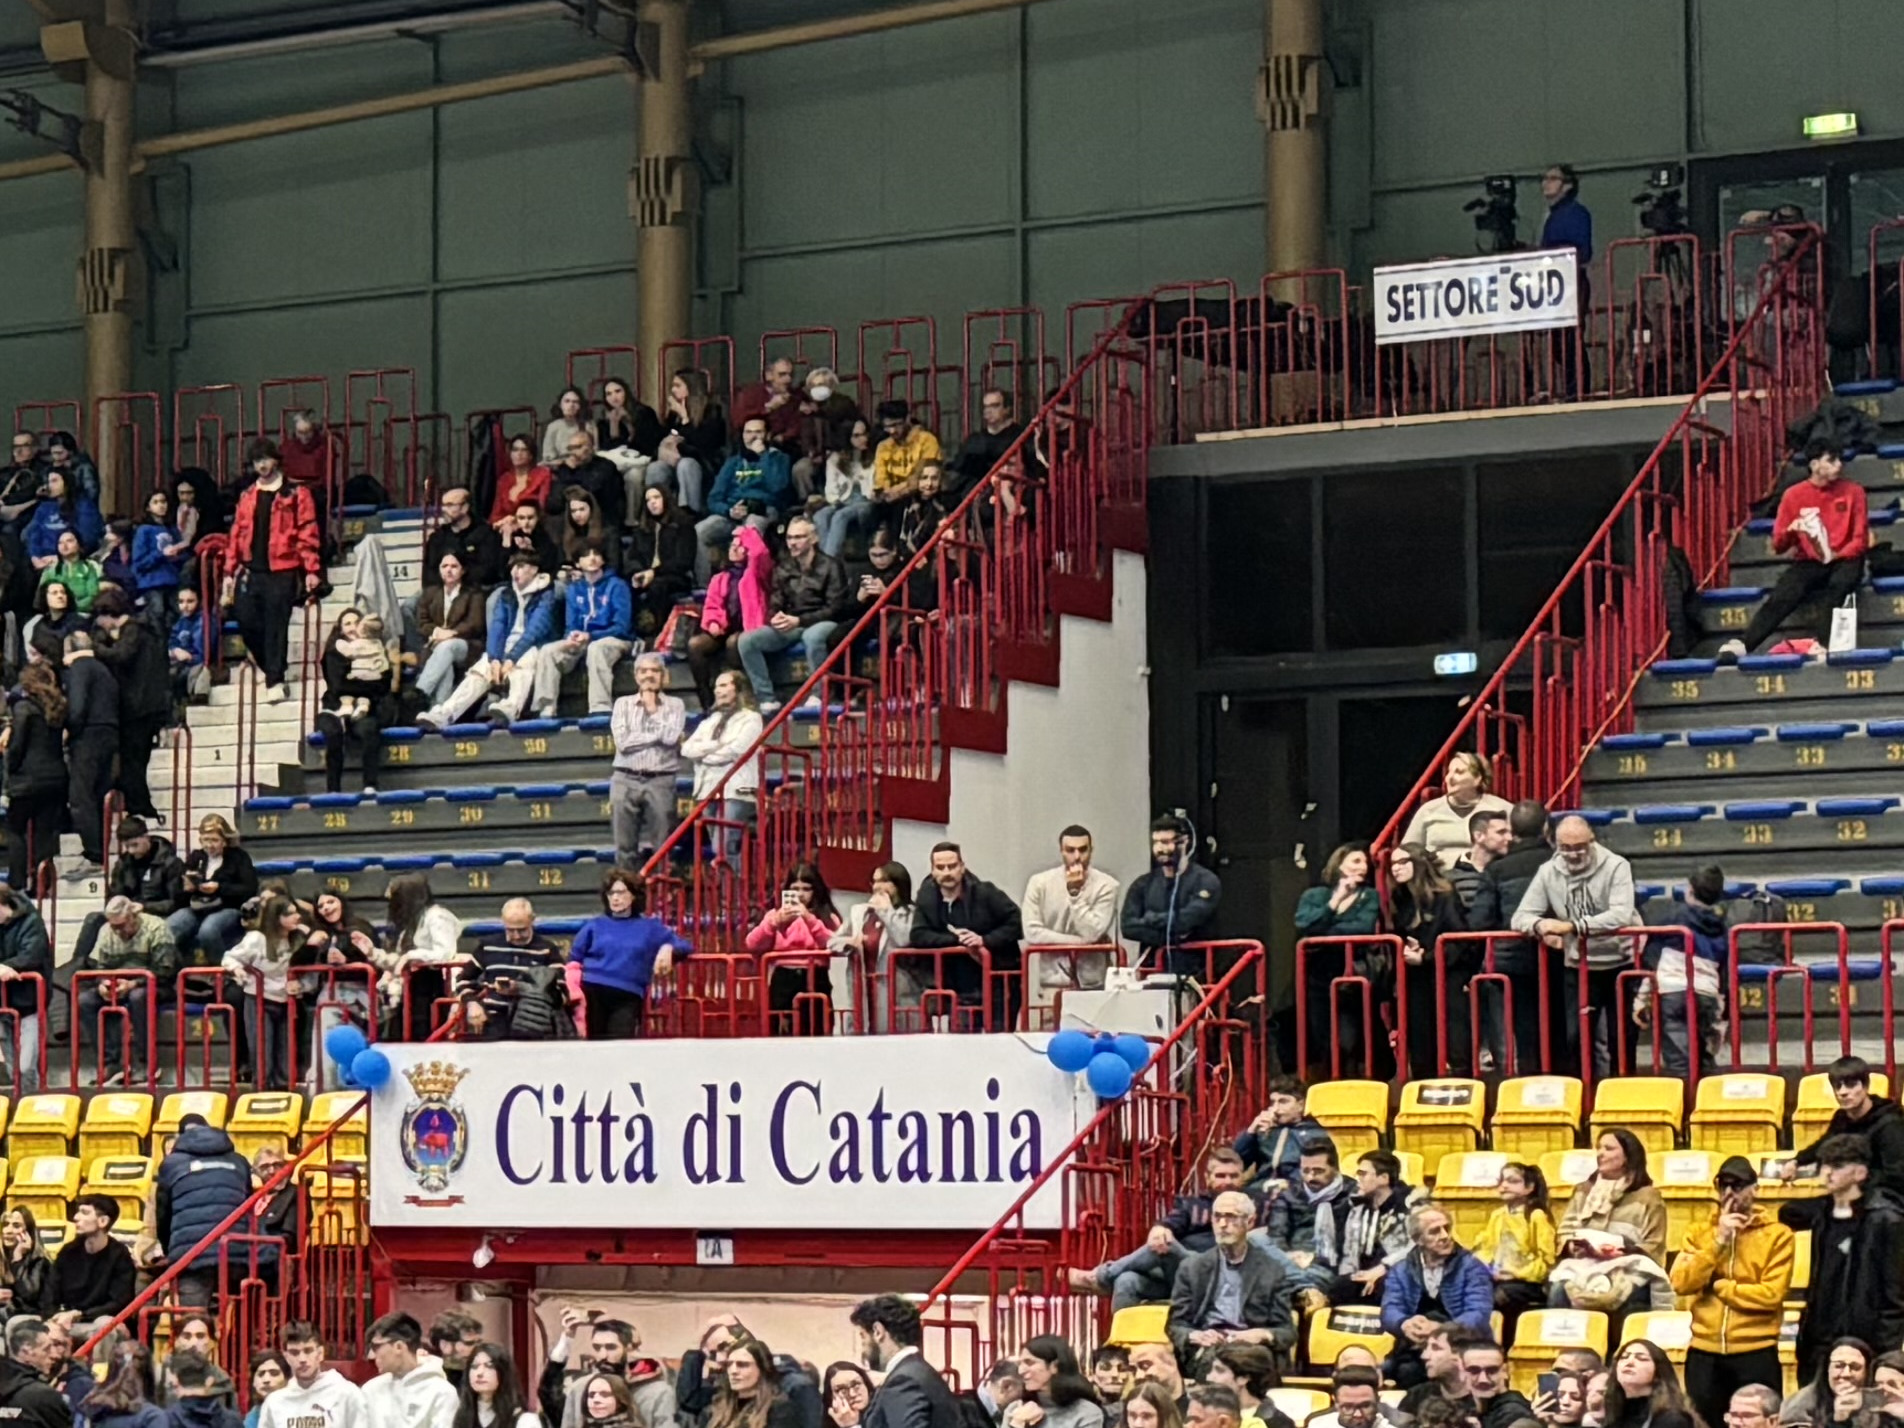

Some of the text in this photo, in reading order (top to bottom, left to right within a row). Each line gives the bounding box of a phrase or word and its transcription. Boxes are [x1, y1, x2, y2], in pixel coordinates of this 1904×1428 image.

[1387, 269, 1565, 323] SETTORE SUD
[1672, 670, 1875, 698] 35 34 33
[1707, 752, 1736, 768] 34
[1796, 747, 1825, 765] 33
[460, 807, 482, 823] 30
[531, 804, 551, 819] 31
[1837, 822, 1867, 840] 32
[539, 869, 562, 885] 32
[495, 1077, 1043, 1186] Città di Catania
